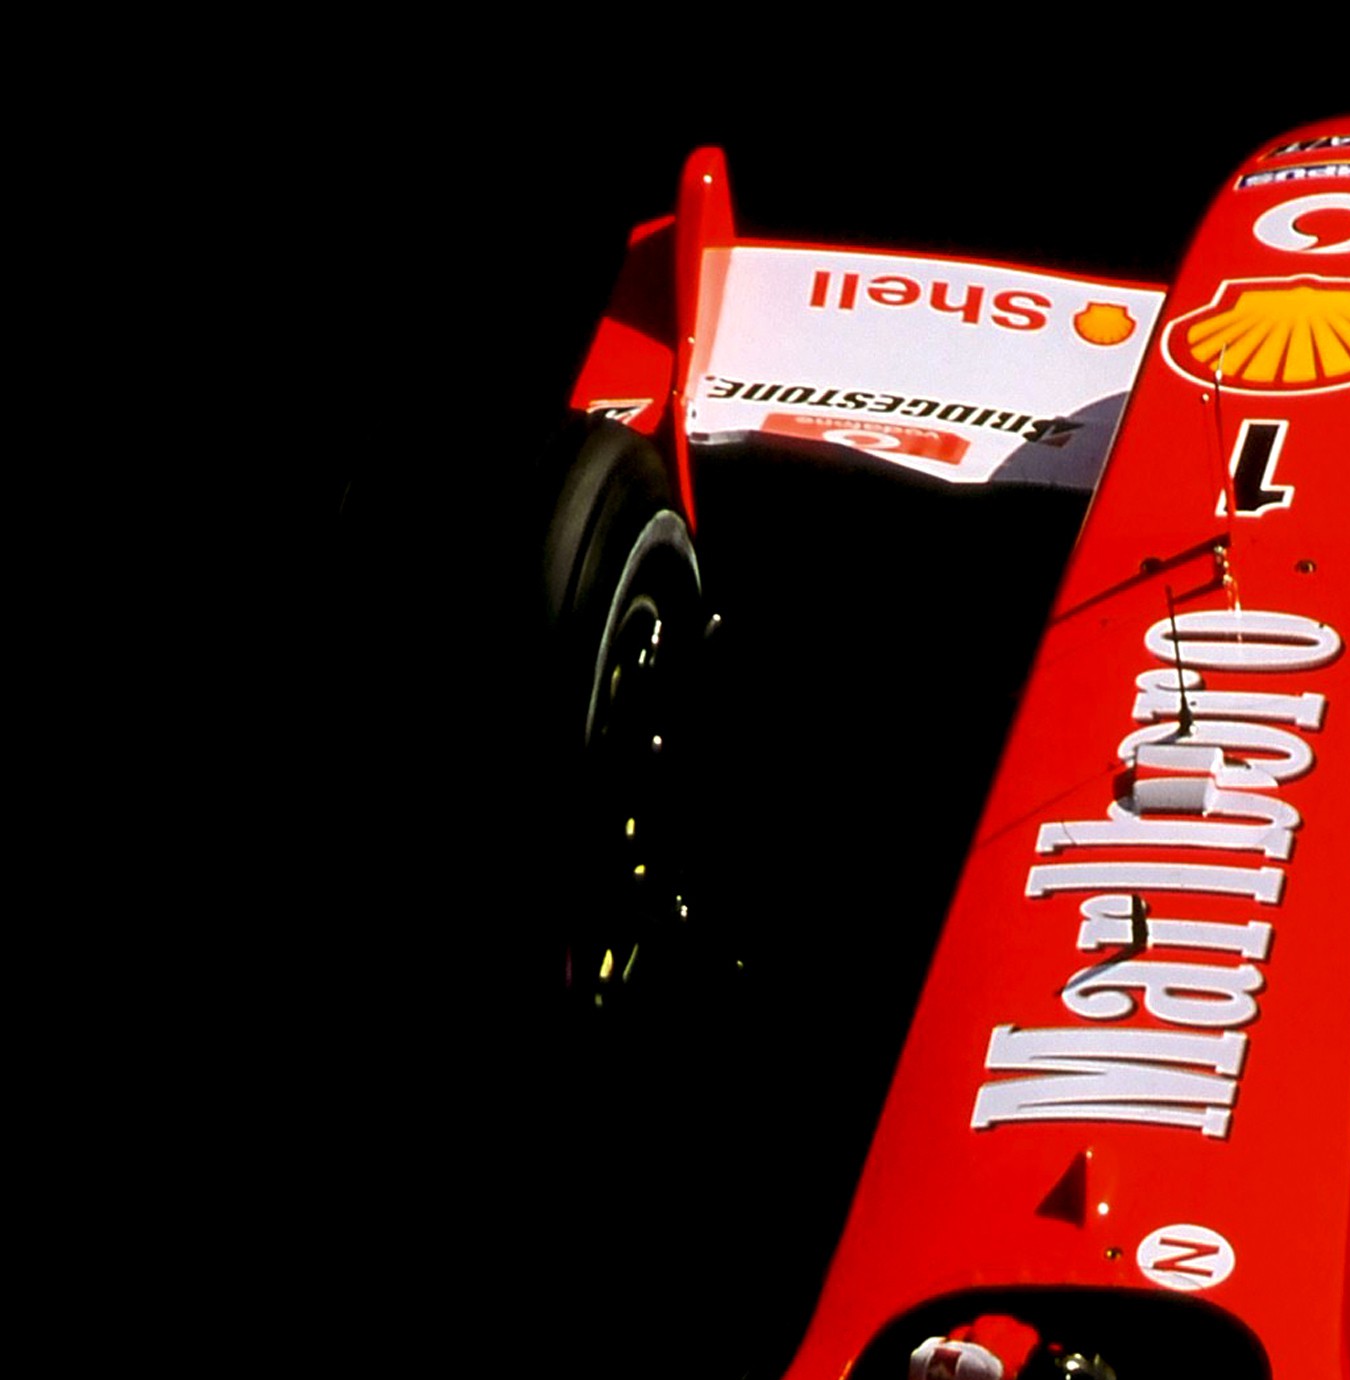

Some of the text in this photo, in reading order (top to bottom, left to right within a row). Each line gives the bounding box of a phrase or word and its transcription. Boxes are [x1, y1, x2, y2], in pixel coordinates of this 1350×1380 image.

[808, 271, 1054, 331] Shell
[707, 376, 1085, 446] BRIDGESTONE
[1216, 419, 1294, 517] 1
[969, 608, 1343, 1141] Marlboro
[1152, 1236, 1221, 1278] N
